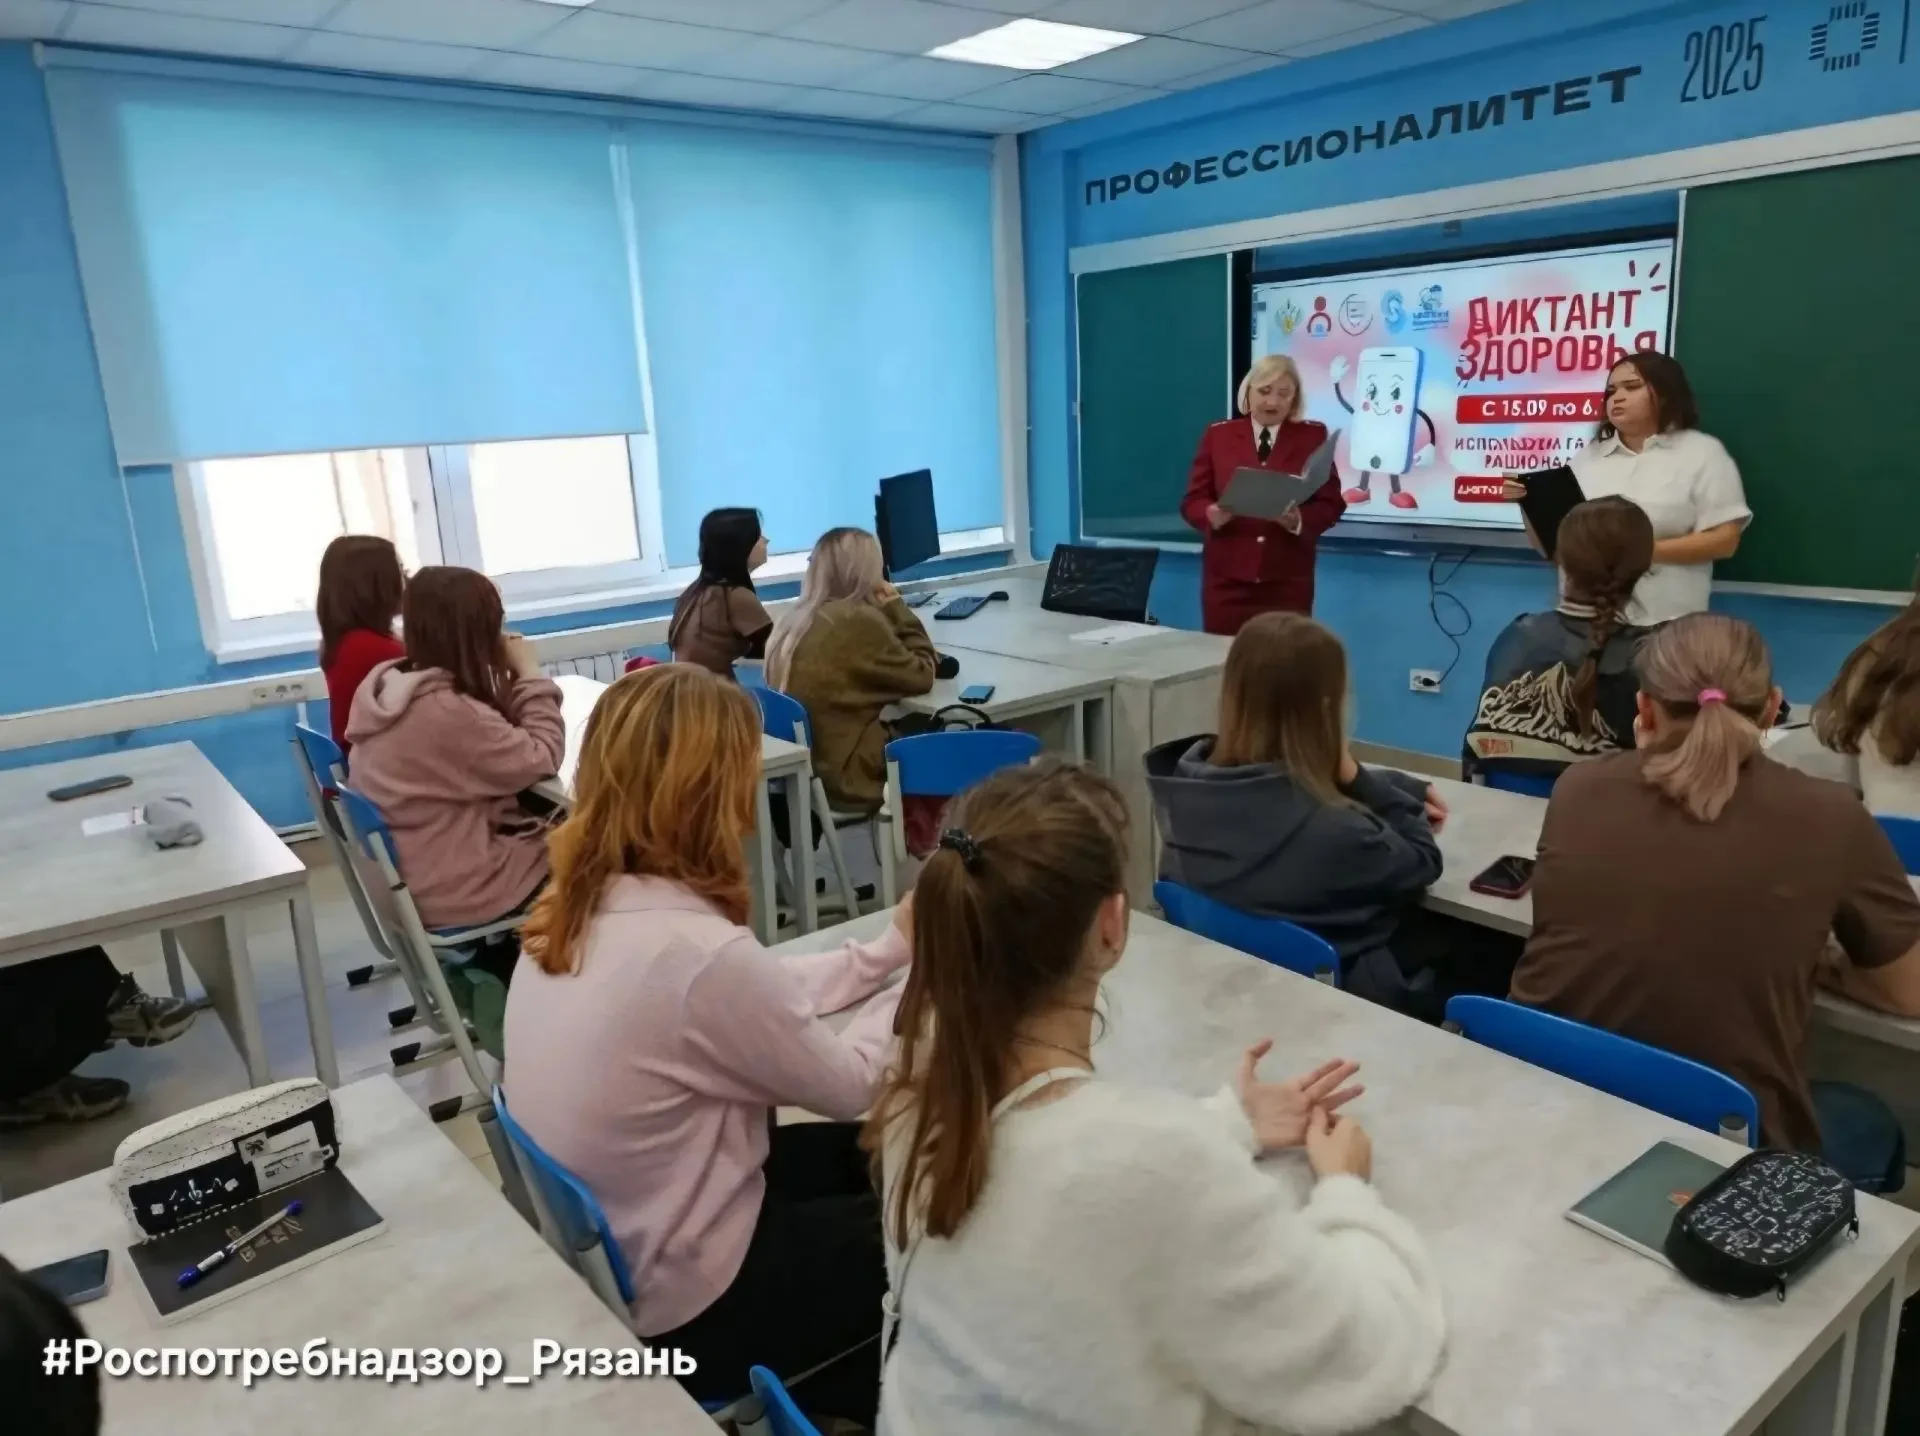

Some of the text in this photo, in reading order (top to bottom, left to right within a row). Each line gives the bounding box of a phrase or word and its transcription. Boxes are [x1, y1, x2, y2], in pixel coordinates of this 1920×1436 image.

[1679, 15, 1769, 103] 2025
[1085, 65, 1642, 205] ПРОФЕССИОНАЛИТЕТ
[1467, 290, 1641, 339] ДИКТАНТ
[1502, 399, 1547, 416] 15.09
[1552, 403, 1576, 416] по
